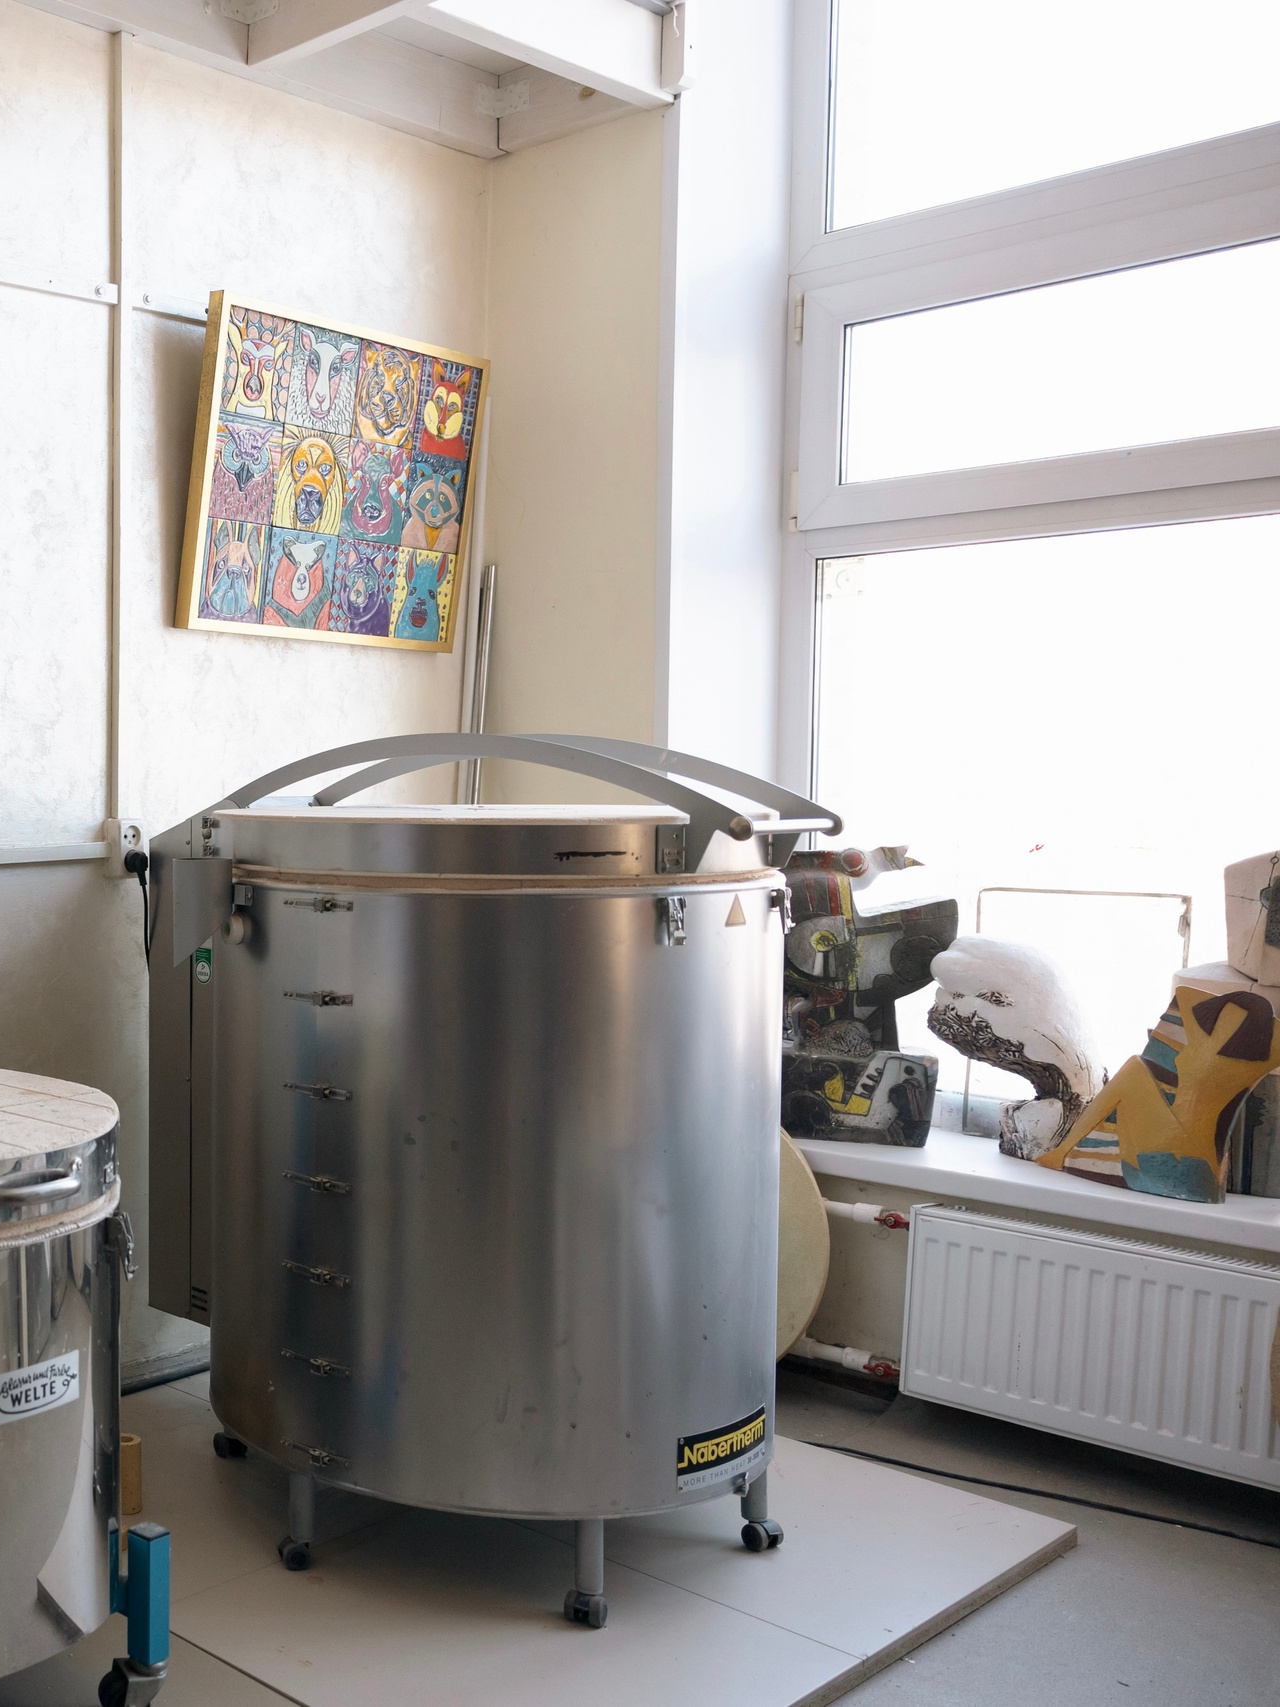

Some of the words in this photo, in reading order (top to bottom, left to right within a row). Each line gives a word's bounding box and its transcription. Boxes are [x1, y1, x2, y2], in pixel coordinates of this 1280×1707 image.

[10, 1380, 57, 1408] WELTE
[678, 1414, 765, 1468] Nabertherm
[683, 1475, 706, 1487] MORE
[710, 1468, 729, 1480] THAN
[731, 1460, 746, 1472] HEAT
